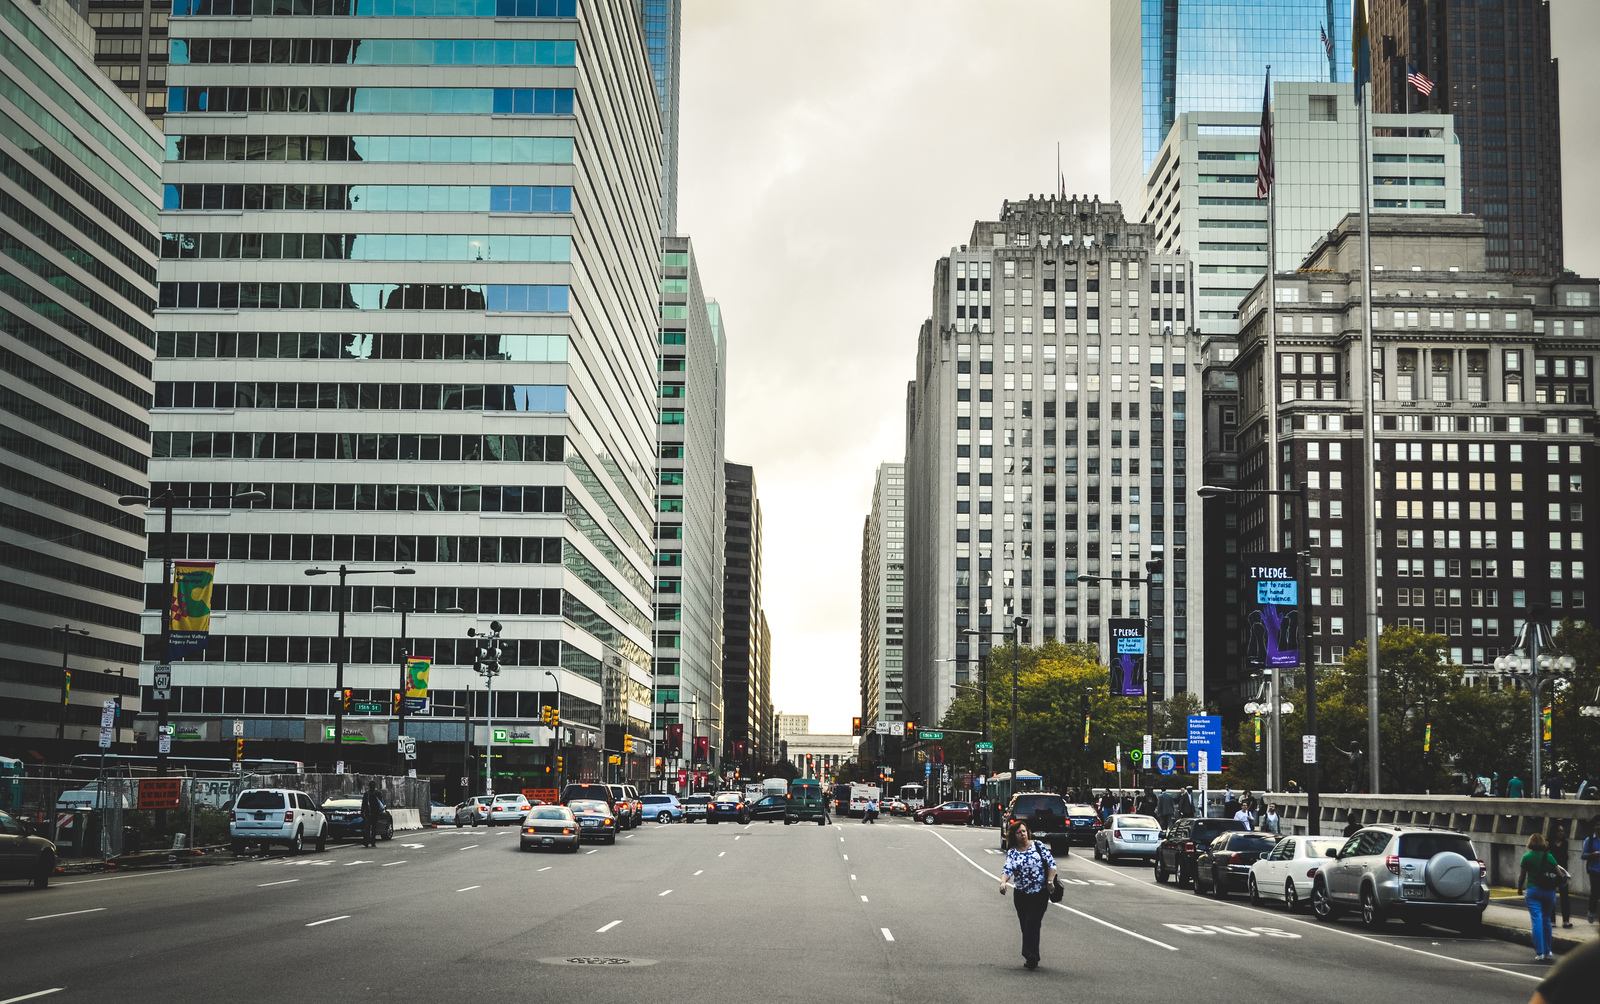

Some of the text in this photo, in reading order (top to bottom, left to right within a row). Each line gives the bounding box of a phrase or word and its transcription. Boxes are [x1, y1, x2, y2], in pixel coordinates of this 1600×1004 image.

[1250, 567, 1257, 578] I
[157, 677, 167, 686] 611
[495, 731, 506, 740] TD
[1161, 923, 1303, 938] BUS
